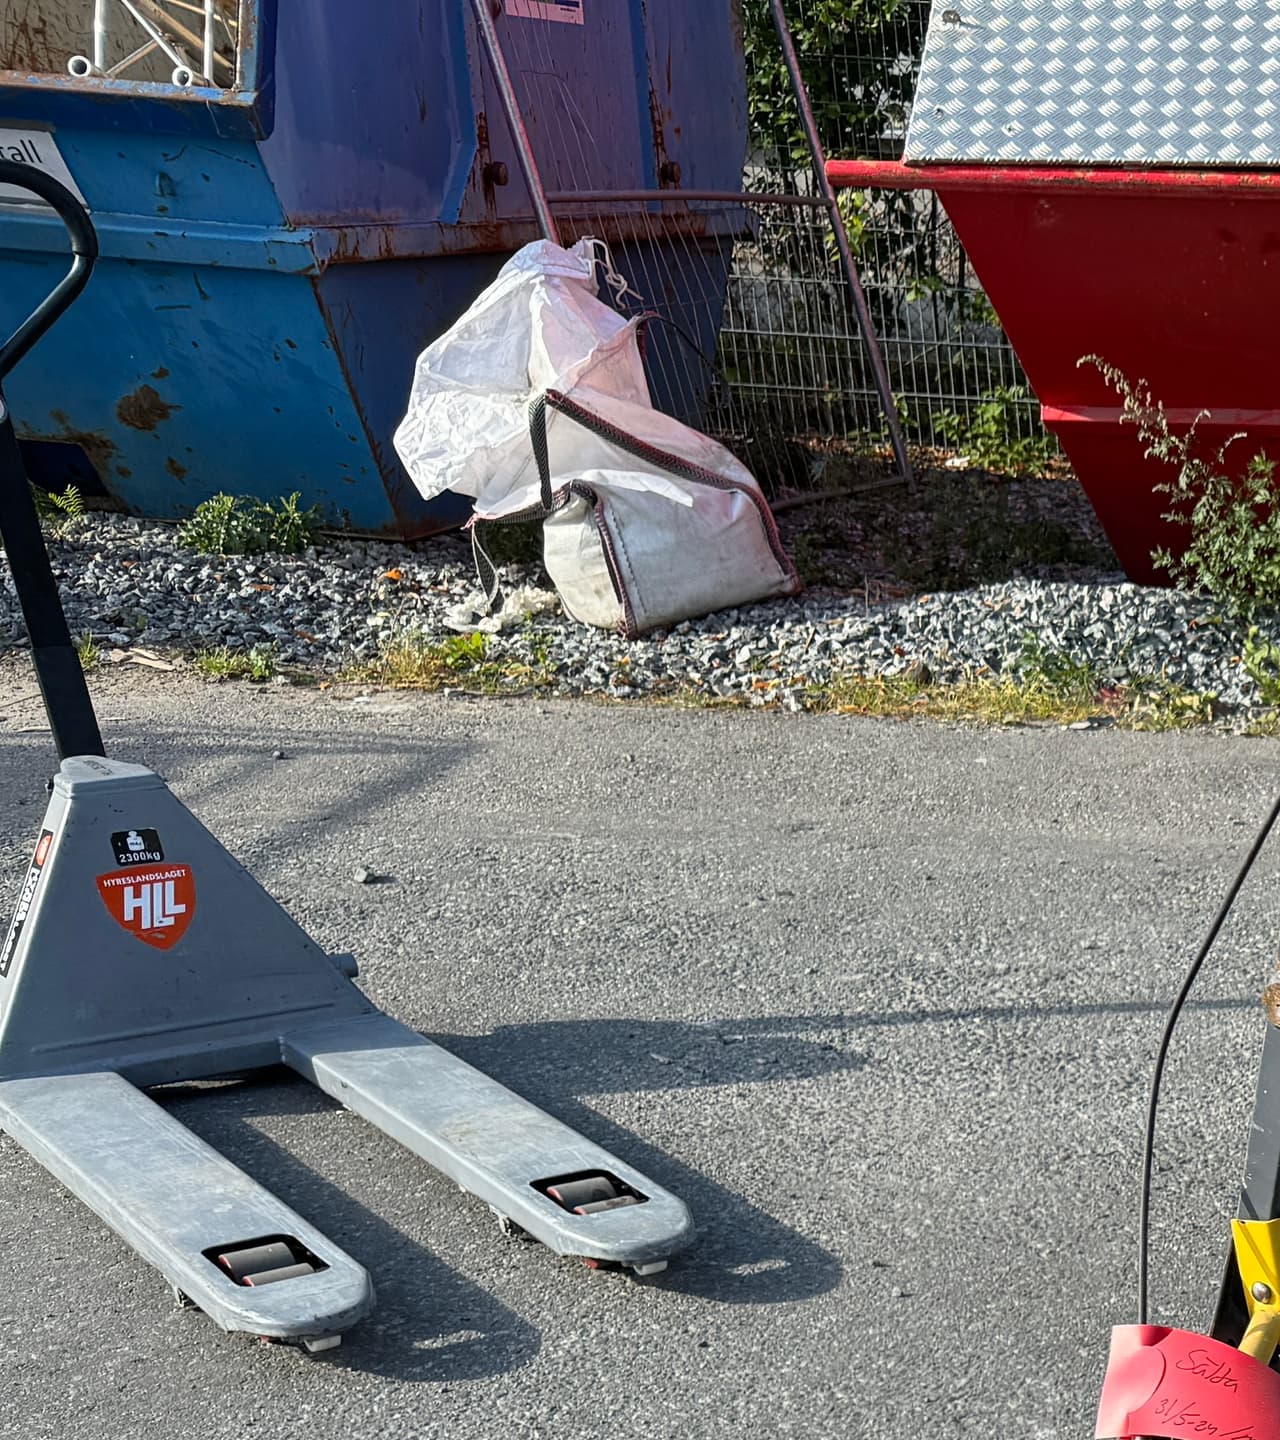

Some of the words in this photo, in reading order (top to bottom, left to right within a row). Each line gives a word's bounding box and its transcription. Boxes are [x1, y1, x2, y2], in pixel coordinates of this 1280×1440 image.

[119, 851, 161, 863] 2300kg
[103, 869, 186, 888] HYRESLANDSLAGET
[124, 881, 186, 930] HLL
